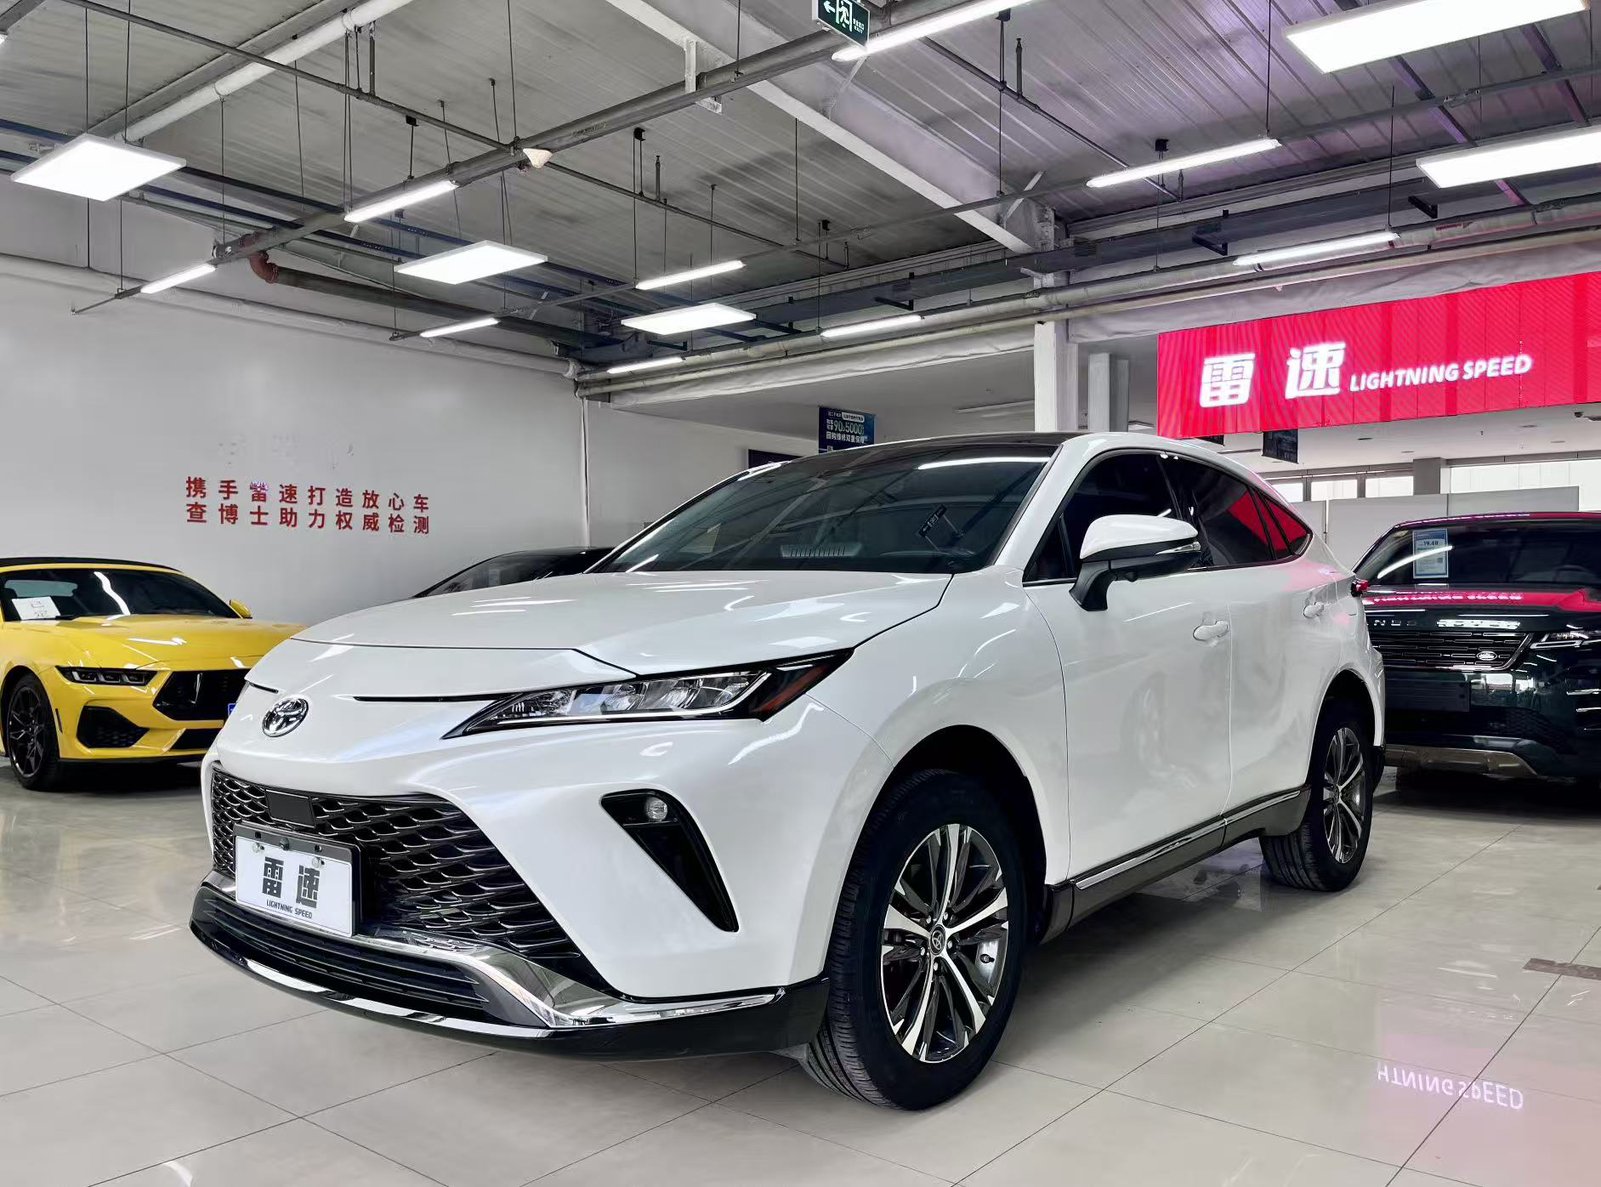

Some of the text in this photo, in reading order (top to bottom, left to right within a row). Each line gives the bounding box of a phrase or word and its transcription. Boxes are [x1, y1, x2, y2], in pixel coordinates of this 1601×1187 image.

[1198, 341, 1533, 408] 雷速 LIGHTNING SPEED
[185, 476, 429, 513] 携手雷速打造放心车
[186, 501, 430, 535] 查博士助力权威检测
[266, 899, 313, 919] LIGHTNING SPEED
